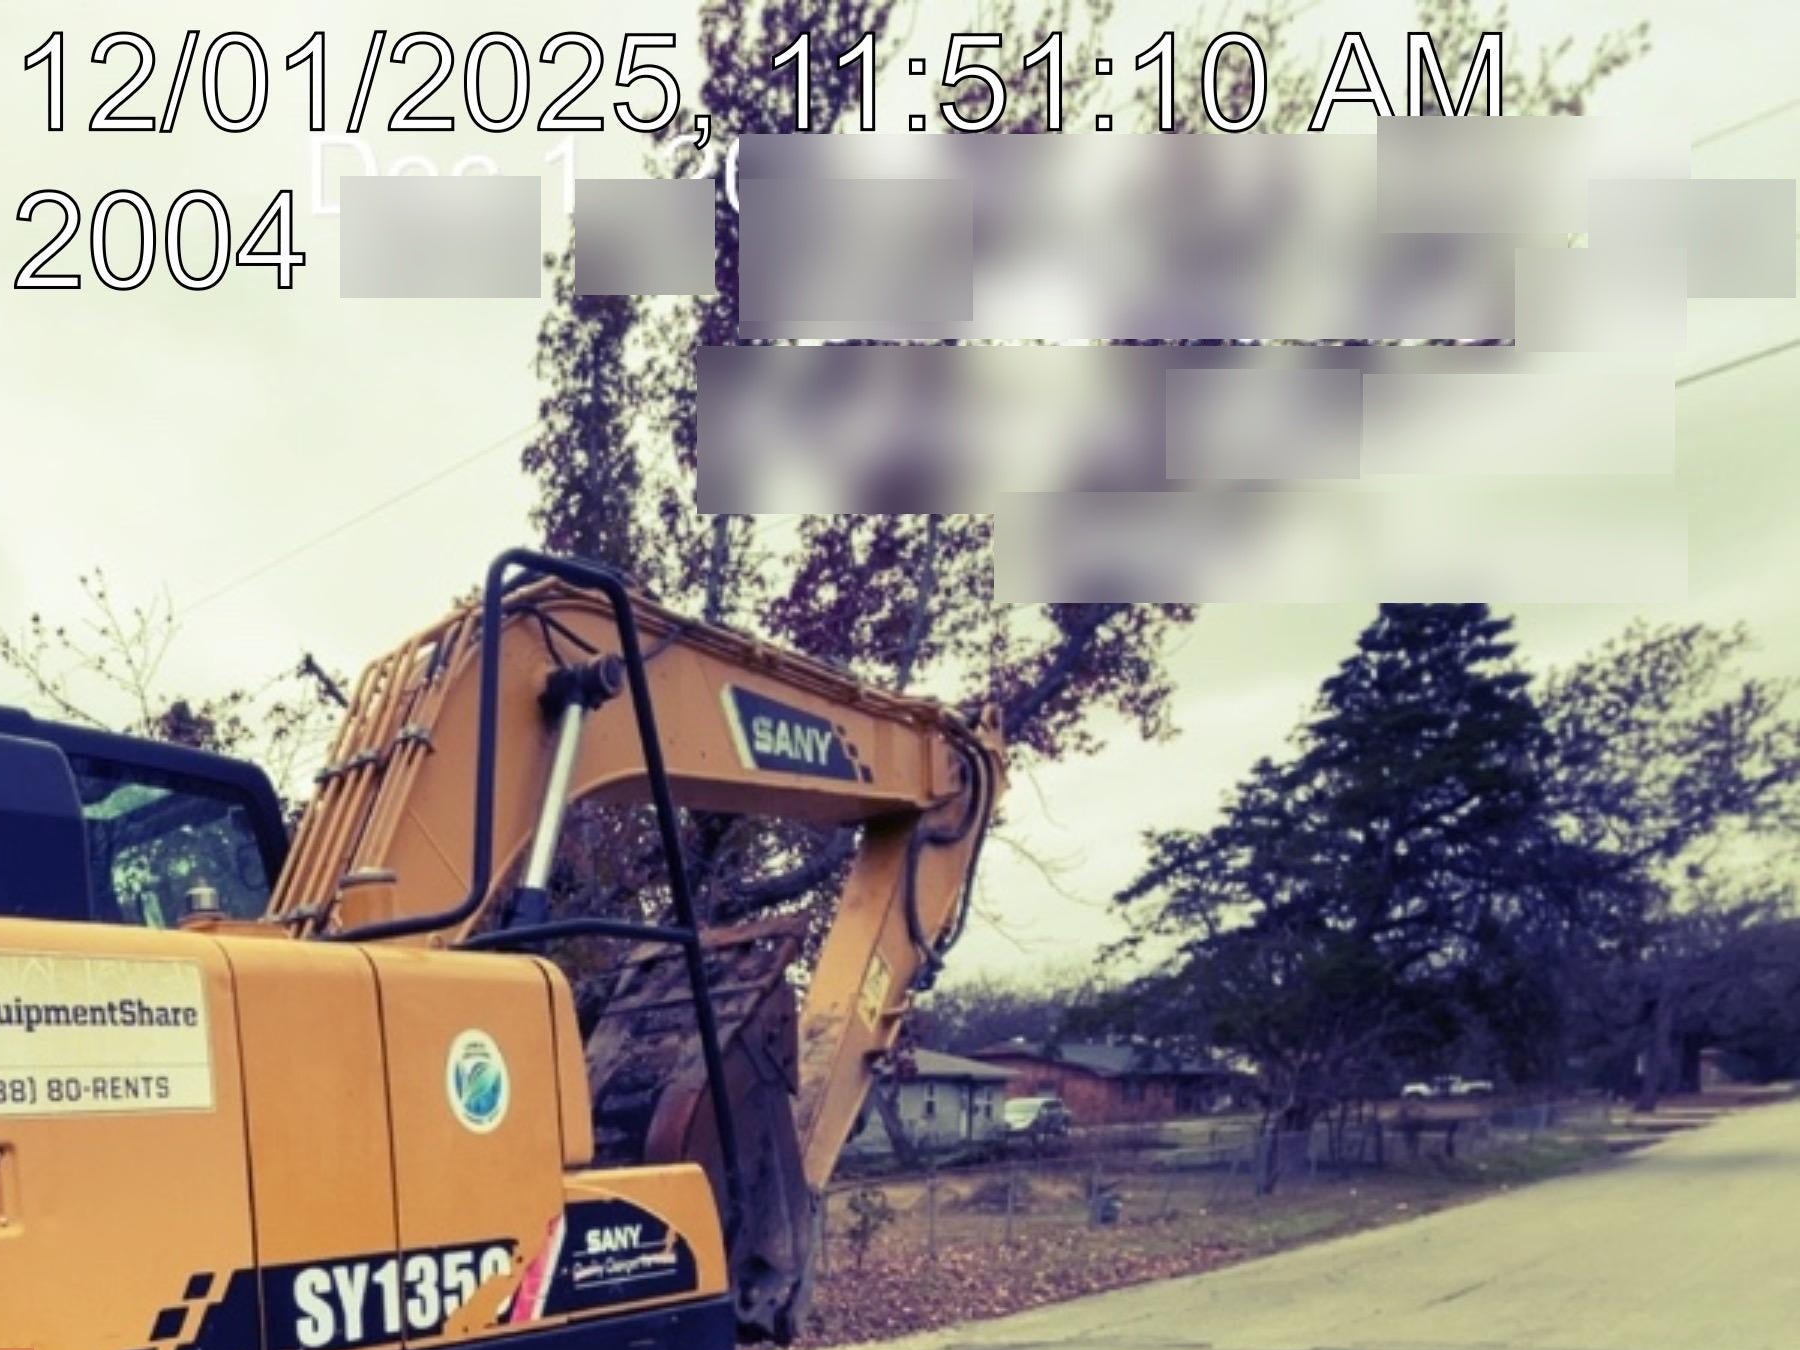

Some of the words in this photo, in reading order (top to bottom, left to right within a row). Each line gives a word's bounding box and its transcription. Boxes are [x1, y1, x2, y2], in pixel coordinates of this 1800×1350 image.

[752, 715, 832, 766] SANY
[46, 1075, 170, 1102] 80-RENTS
[585, 1223, 643, 1255] SANY
